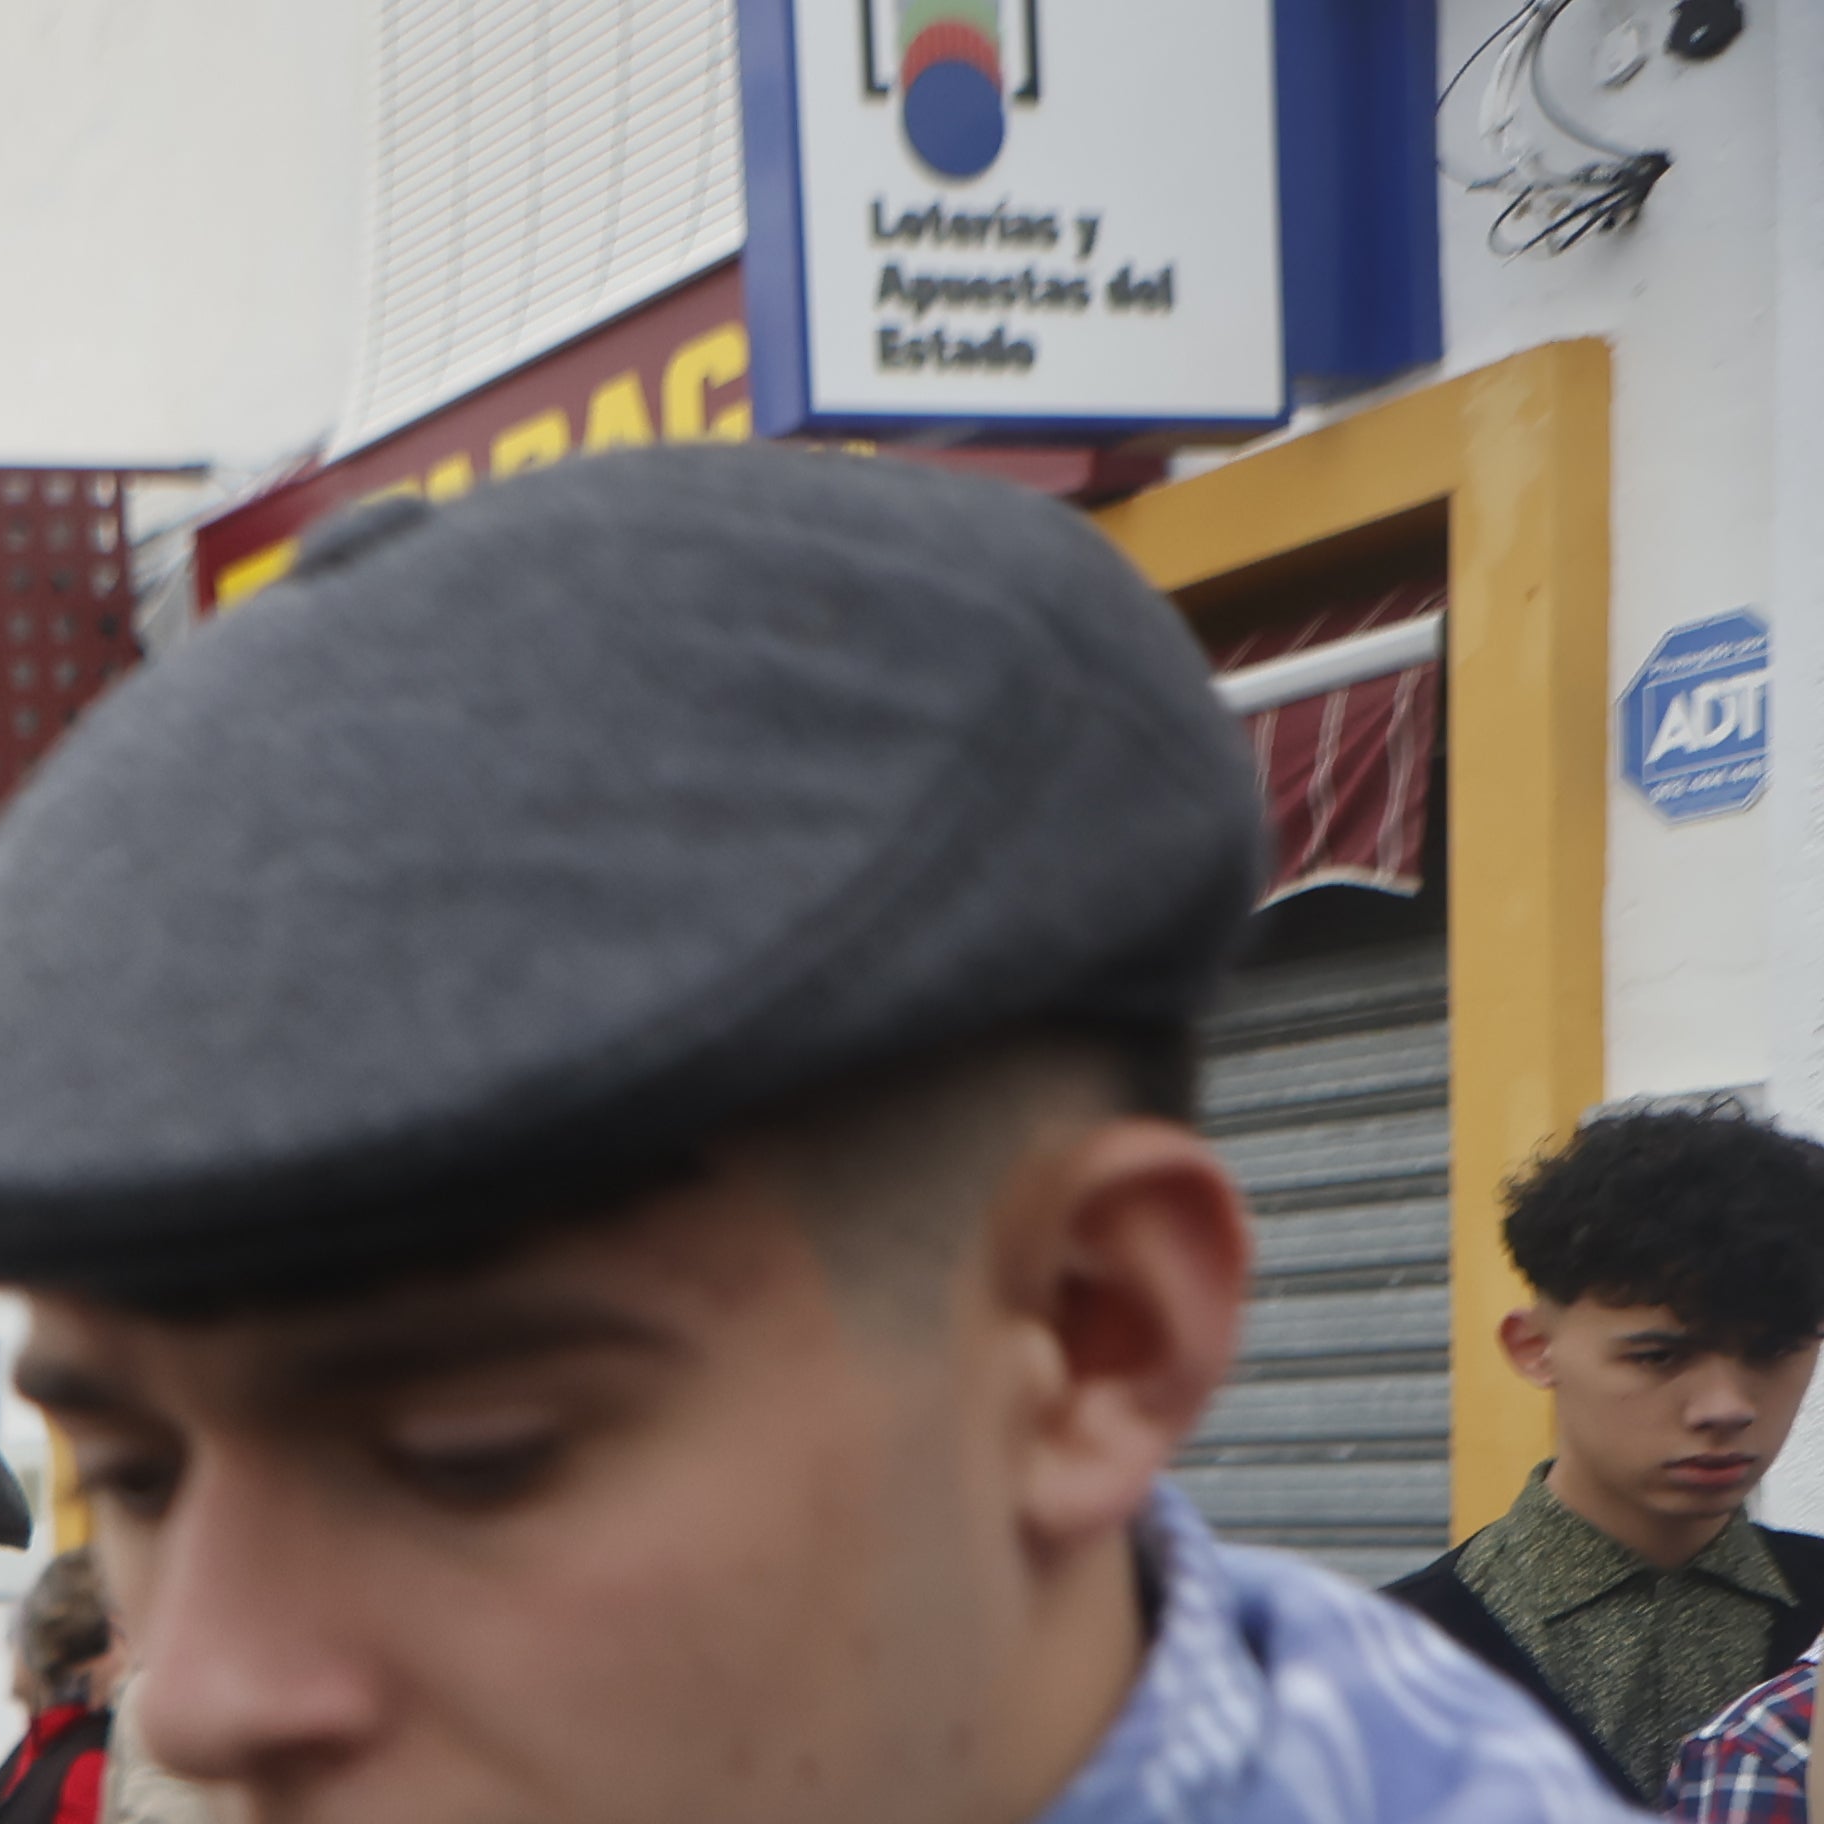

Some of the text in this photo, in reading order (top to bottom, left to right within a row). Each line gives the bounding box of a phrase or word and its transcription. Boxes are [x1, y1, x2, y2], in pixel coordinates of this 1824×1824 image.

[869, 197, 1102, 261] Loterías y
[875, 264, 1174, 315] Apuestas del
[876, 324, 1036, 369] Estado
[1643, 667, 1770, 767] ADT
